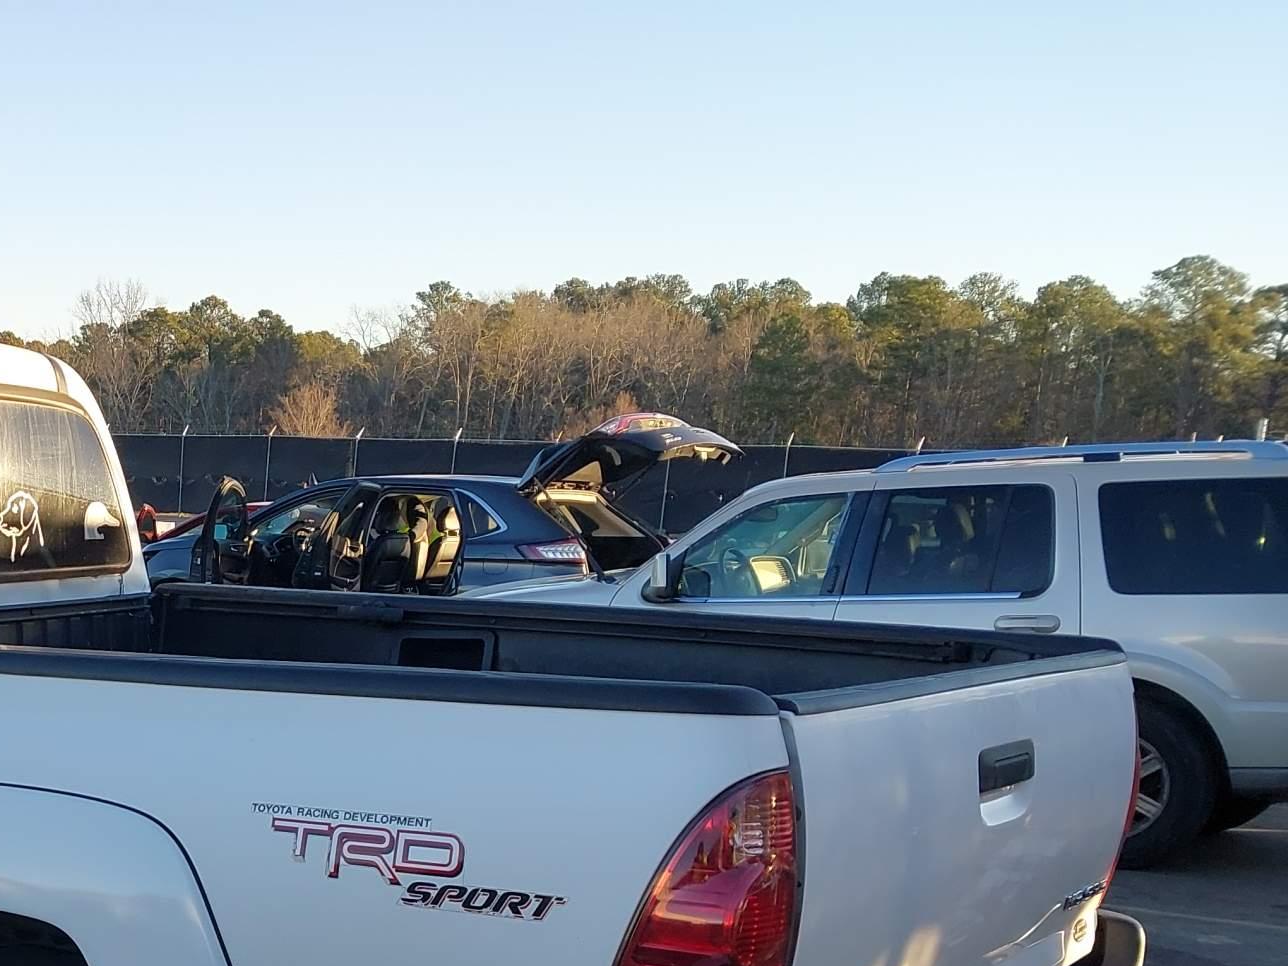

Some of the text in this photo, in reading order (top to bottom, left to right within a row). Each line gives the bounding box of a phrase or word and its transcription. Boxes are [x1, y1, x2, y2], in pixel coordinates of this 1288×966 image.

[252, 802, 432, 828] TOYOTA RACING DEVELOPMENT
[271, 816, 465, 885] TRD
[399, 881, 569, 921] SPORT
